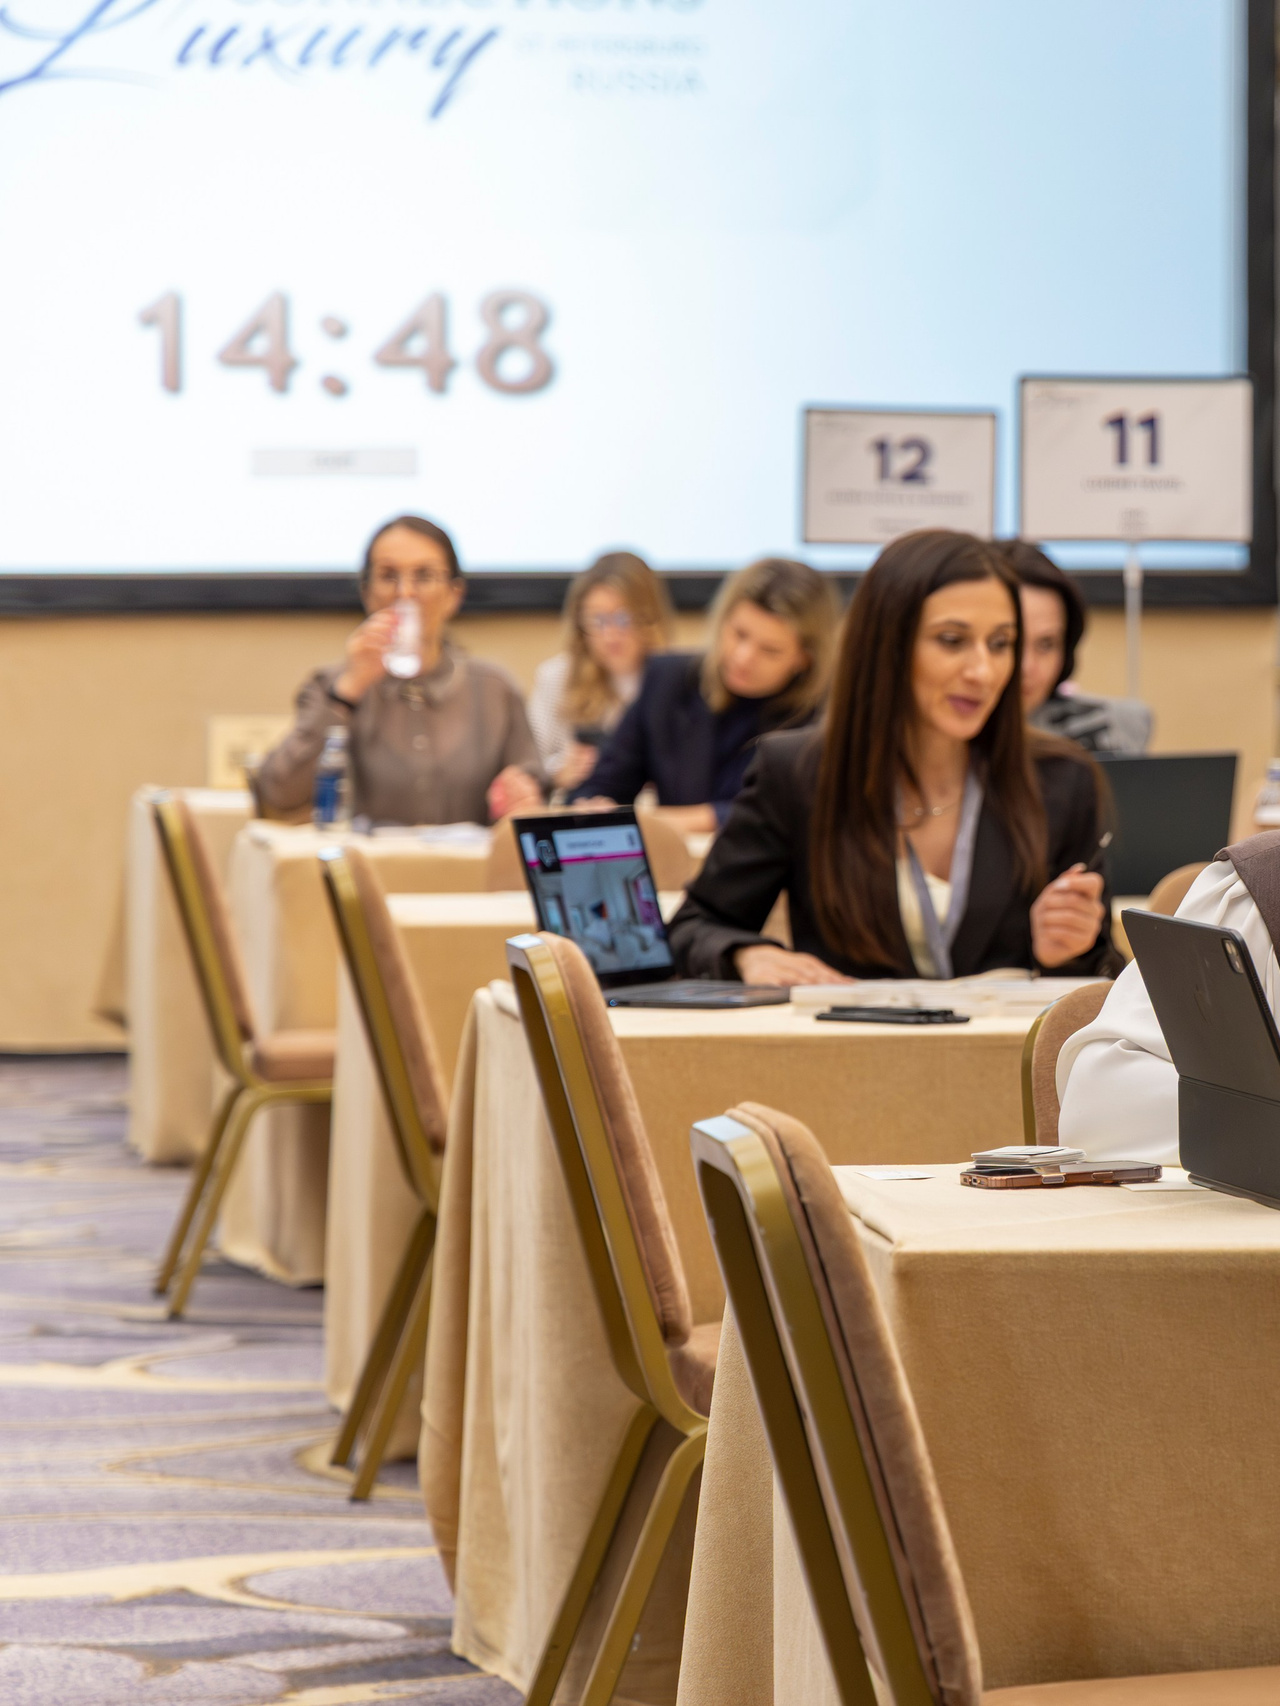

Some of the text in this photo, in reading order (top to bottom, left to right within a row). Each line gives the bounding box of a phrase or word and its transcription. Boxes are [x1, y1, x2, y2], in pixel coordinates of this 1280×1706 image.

[132, 287, 561, 402] 14:48
[873, 439, 932, 485] 12
[1106, 413, 1160, 466] 11
